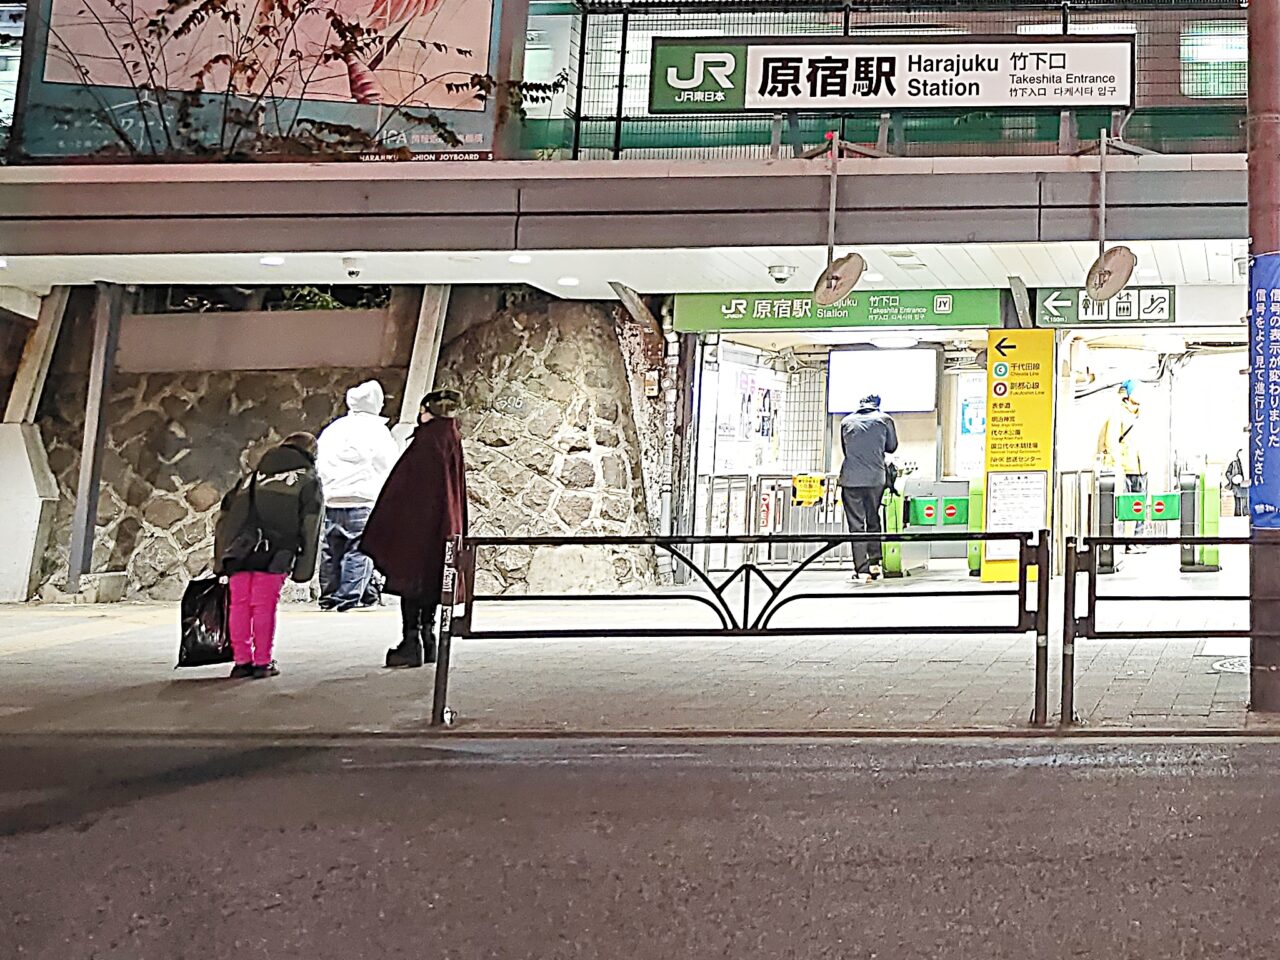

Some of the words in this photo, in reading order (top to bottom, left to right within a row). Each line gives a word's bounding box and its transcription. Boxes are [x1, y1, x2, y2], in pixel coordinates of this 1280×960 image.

[907, 54, 999, 76] Harajuku
[1009, 52, 1067, 71] 竹下口
[666, 52, 736, 89] JR
[757, 56, 897, 98] 原宿駅
[1009, 74, 1063, 85] Takeshita
[1066, 73, 1116, 84] Entrance
[907, 78, 981, 97] Station
[1009, 87, 1047, 98] 竹下入口
[1097, 86, 1117, 97] 입구
[675, 90, 726, 102] JR東日本
[439, 153, 480, 161] JOYBOARD
[721, 299, 747, 314] JR
[752, 298, 812, 319] 原宿駅
[869, 296, 899, 306] 竹下口
[938, 300, 948, 308] JY
[816, 308, 849, 318] Station
[1268, 288, 1280, 448] 信号の表示が変わりました
[1254, 288, 1266, 486] 信号をよく見て進行してください
